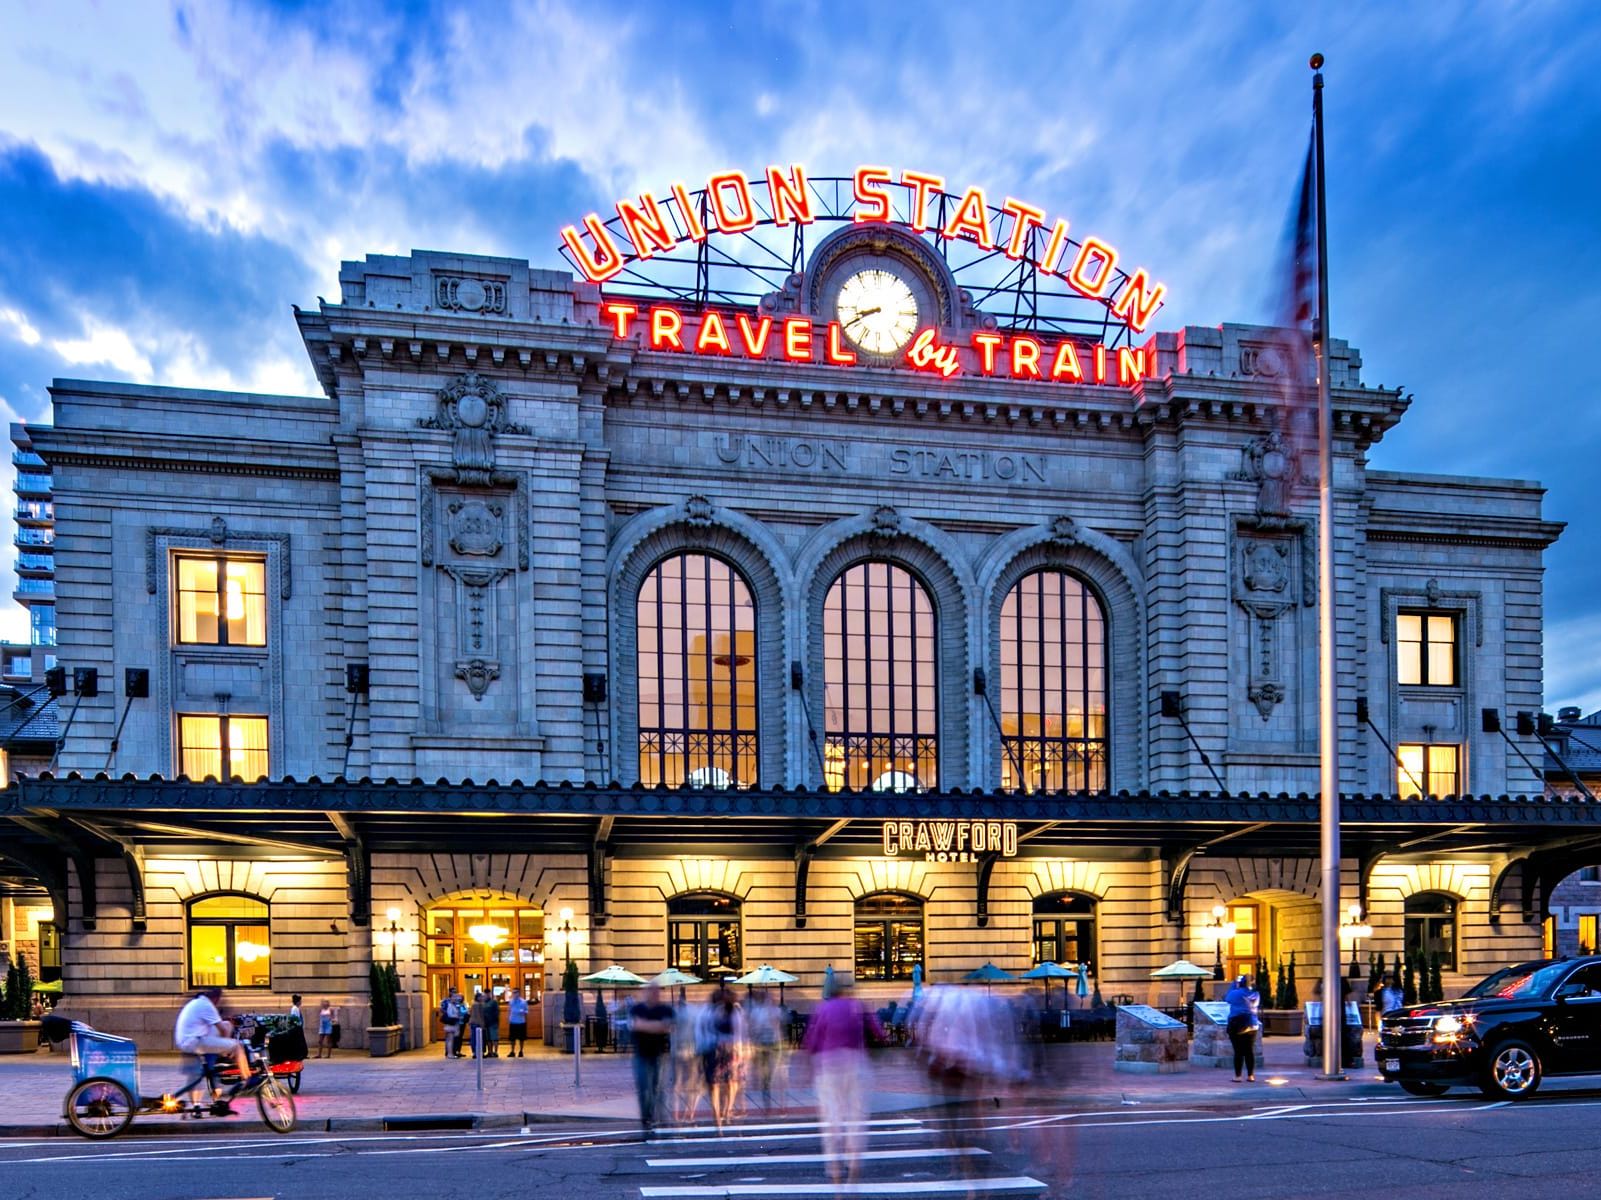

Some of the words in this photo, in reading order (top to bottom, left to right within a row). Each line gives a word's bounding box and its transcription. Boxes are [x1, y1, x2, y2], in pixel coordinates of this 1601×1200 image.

[561, 164, 815, 283] UNION
[852, 165, 1168, 333] STATION
[602, 303, 857, 365] TRAVEL
[905, 329, 961, 378] by
[971, 332, 1147, 387] TRAIN
[713, 436, 849, 471] UNION
[890, 449, 1048, 483] STATION
[883, 821, 1017, 856] CRAWFORD
[925, 852, 979, 863] HOTEL
